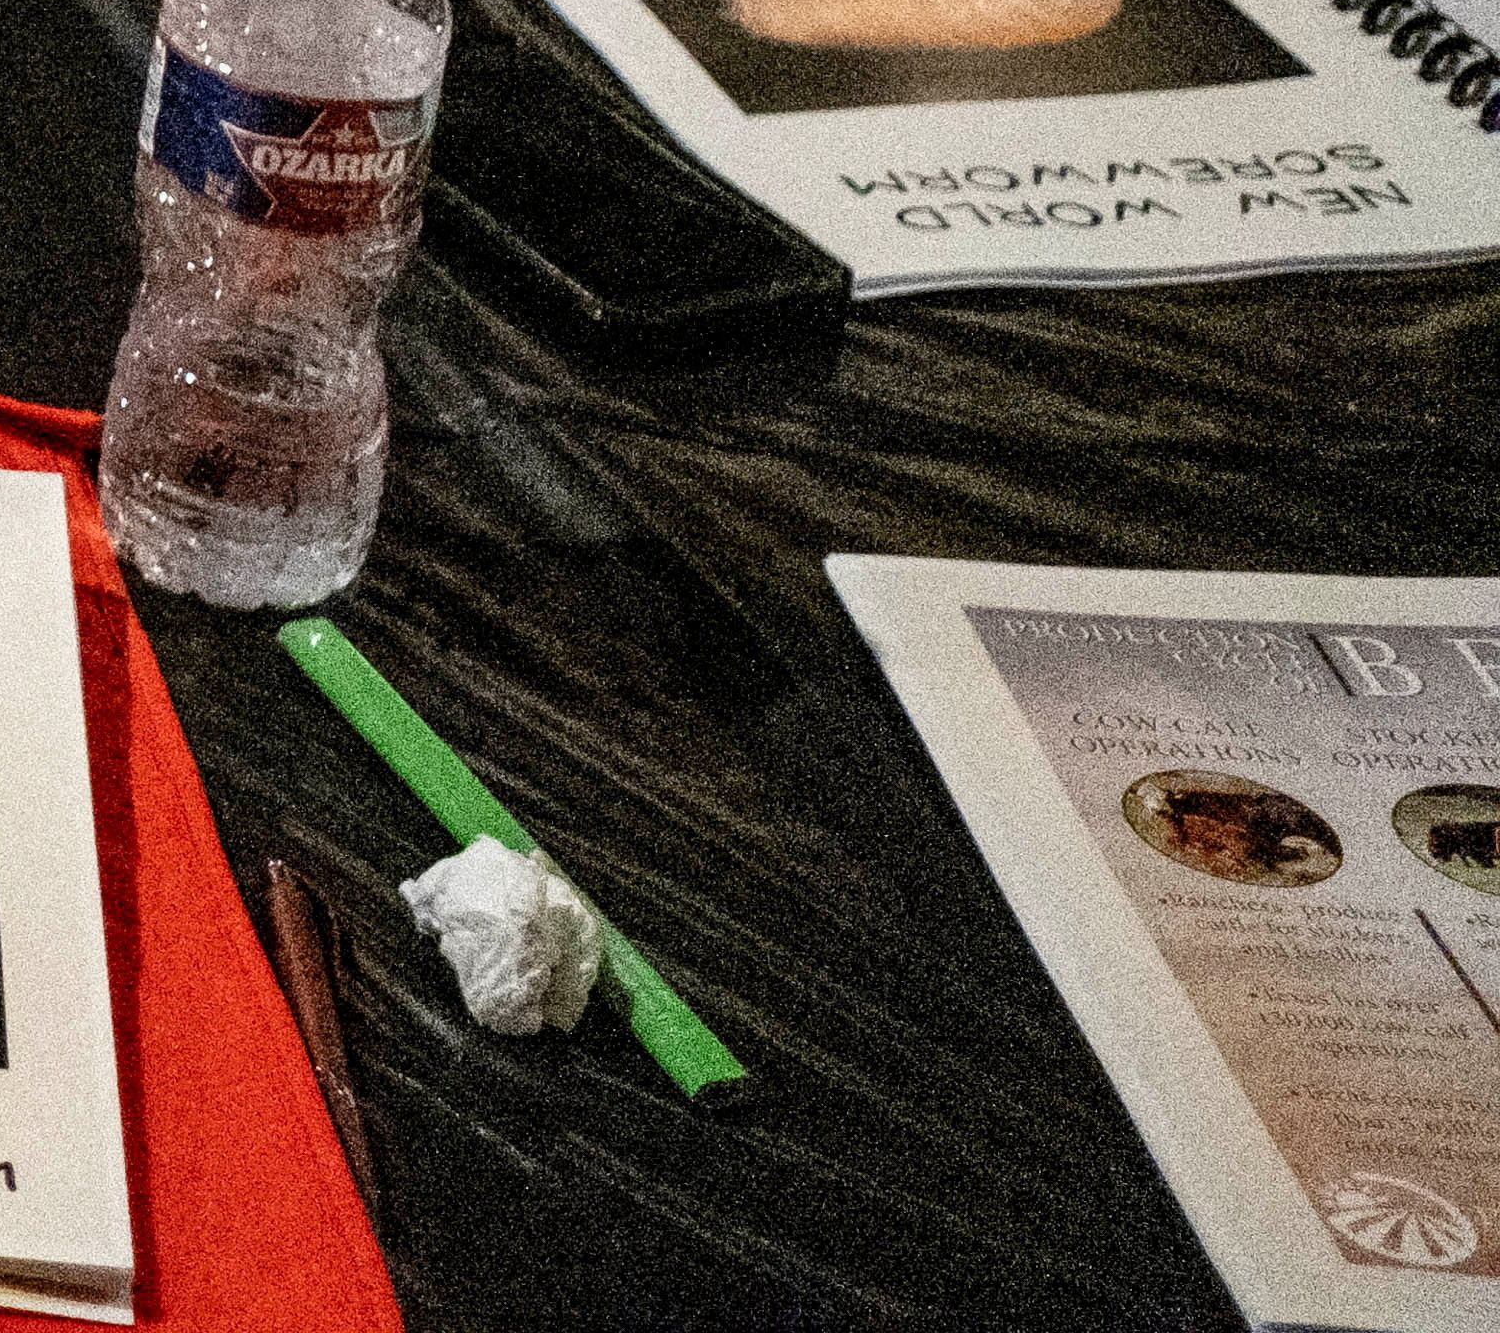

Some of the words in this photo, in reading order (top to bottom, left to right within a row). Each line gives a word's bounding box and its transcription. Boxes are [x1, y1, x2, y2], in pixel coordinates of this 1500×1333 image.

[251, 144, 406, 183] OZARKA
[840, 144, 1384, 197] SCREWWORM
[897, 199, 1182, 231] WORLD
[1240, 183, 1413, 215] NEW
[1068, 734, 1303, 766] OPERATIONS
